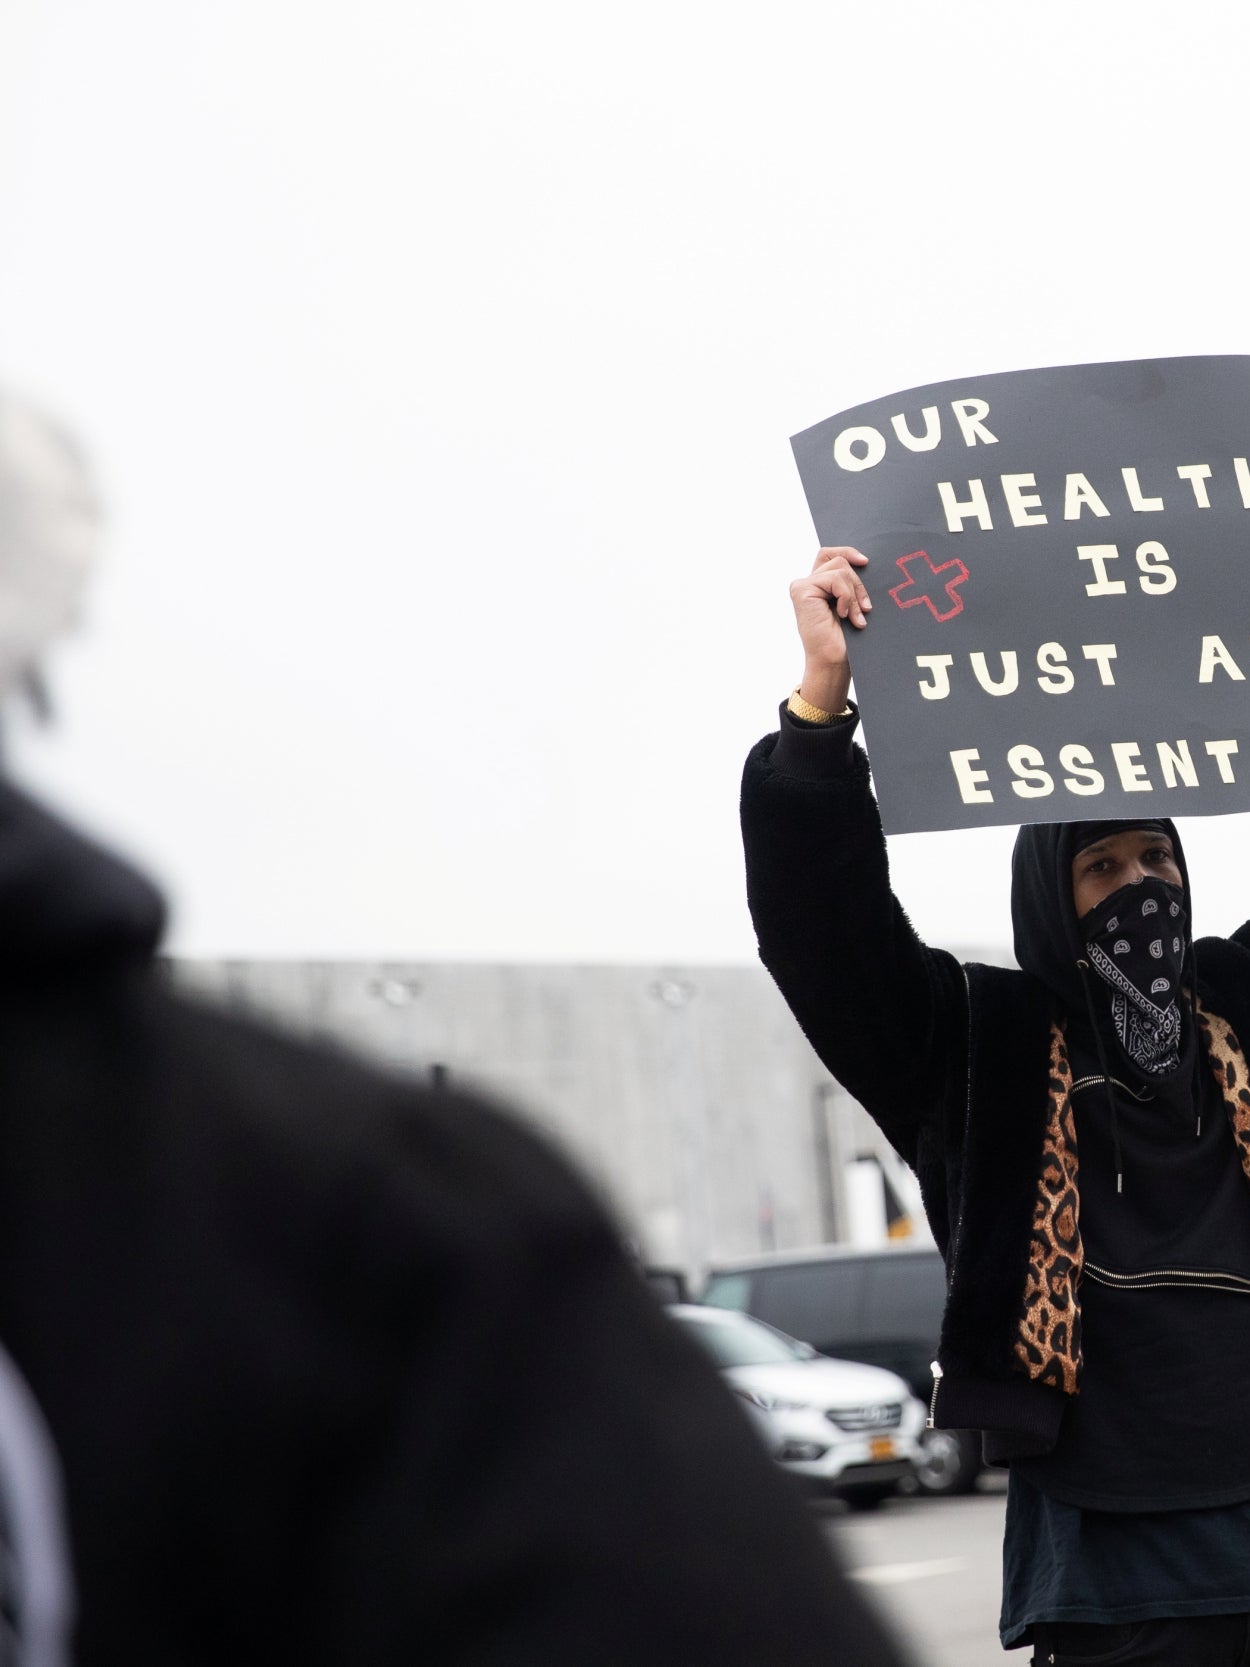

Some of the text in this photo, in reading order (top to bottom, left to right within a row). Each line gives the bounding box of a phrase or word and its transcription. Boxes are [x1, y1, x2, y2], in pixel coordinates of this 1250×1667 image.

[833, 397, 999, 473] OUR
[1076, 540, 1178, 597] IS
[915, 643, 1118, 700] JUST
